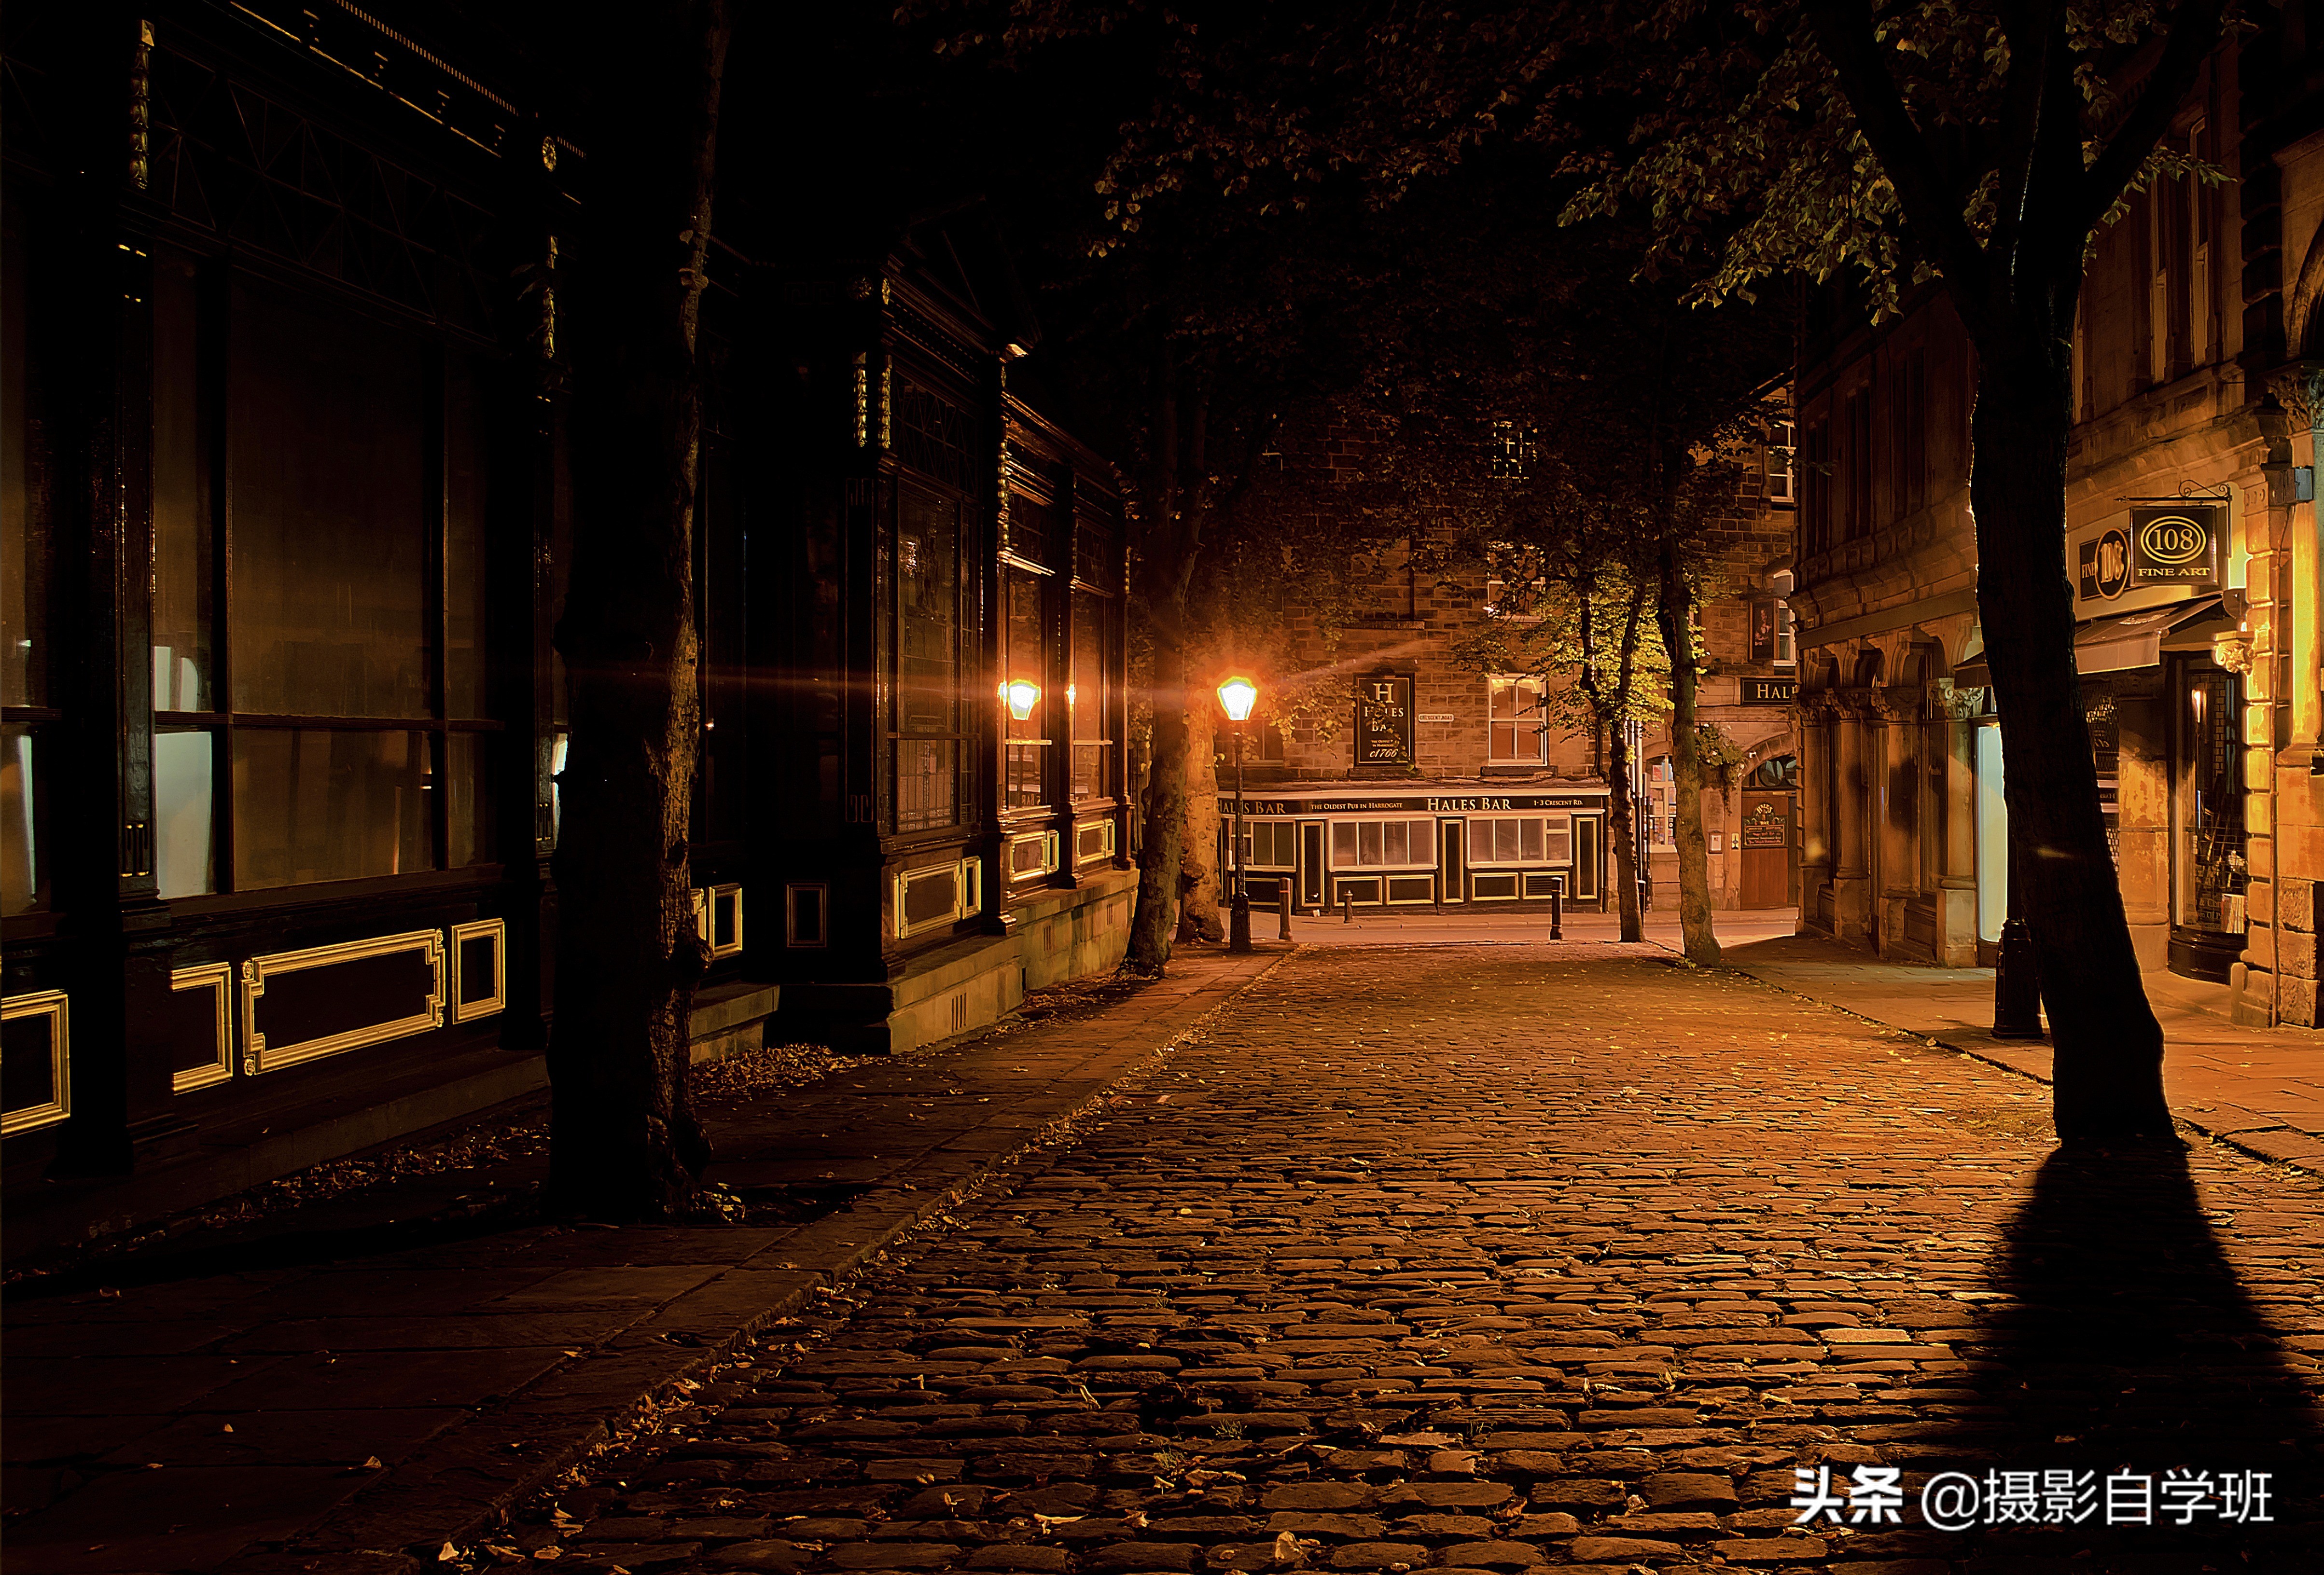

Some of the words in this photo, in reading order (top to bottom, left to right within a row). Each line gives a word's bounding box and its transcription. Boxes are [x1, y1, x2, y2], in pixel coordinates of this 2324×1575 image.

[2154, 528, 2194, 550] 108
[2138, 568, 2175, 576] FINE
[2178, 567, 2211, 576] ART
[1373, 683, 1394, 703] H
[1218, 800, 1250, 814] HALS
[1255, 801, 1286, 814] BAR
[1427, 798, 1476, 811] HALES
[1482, 797, 1512, 810] BAR
